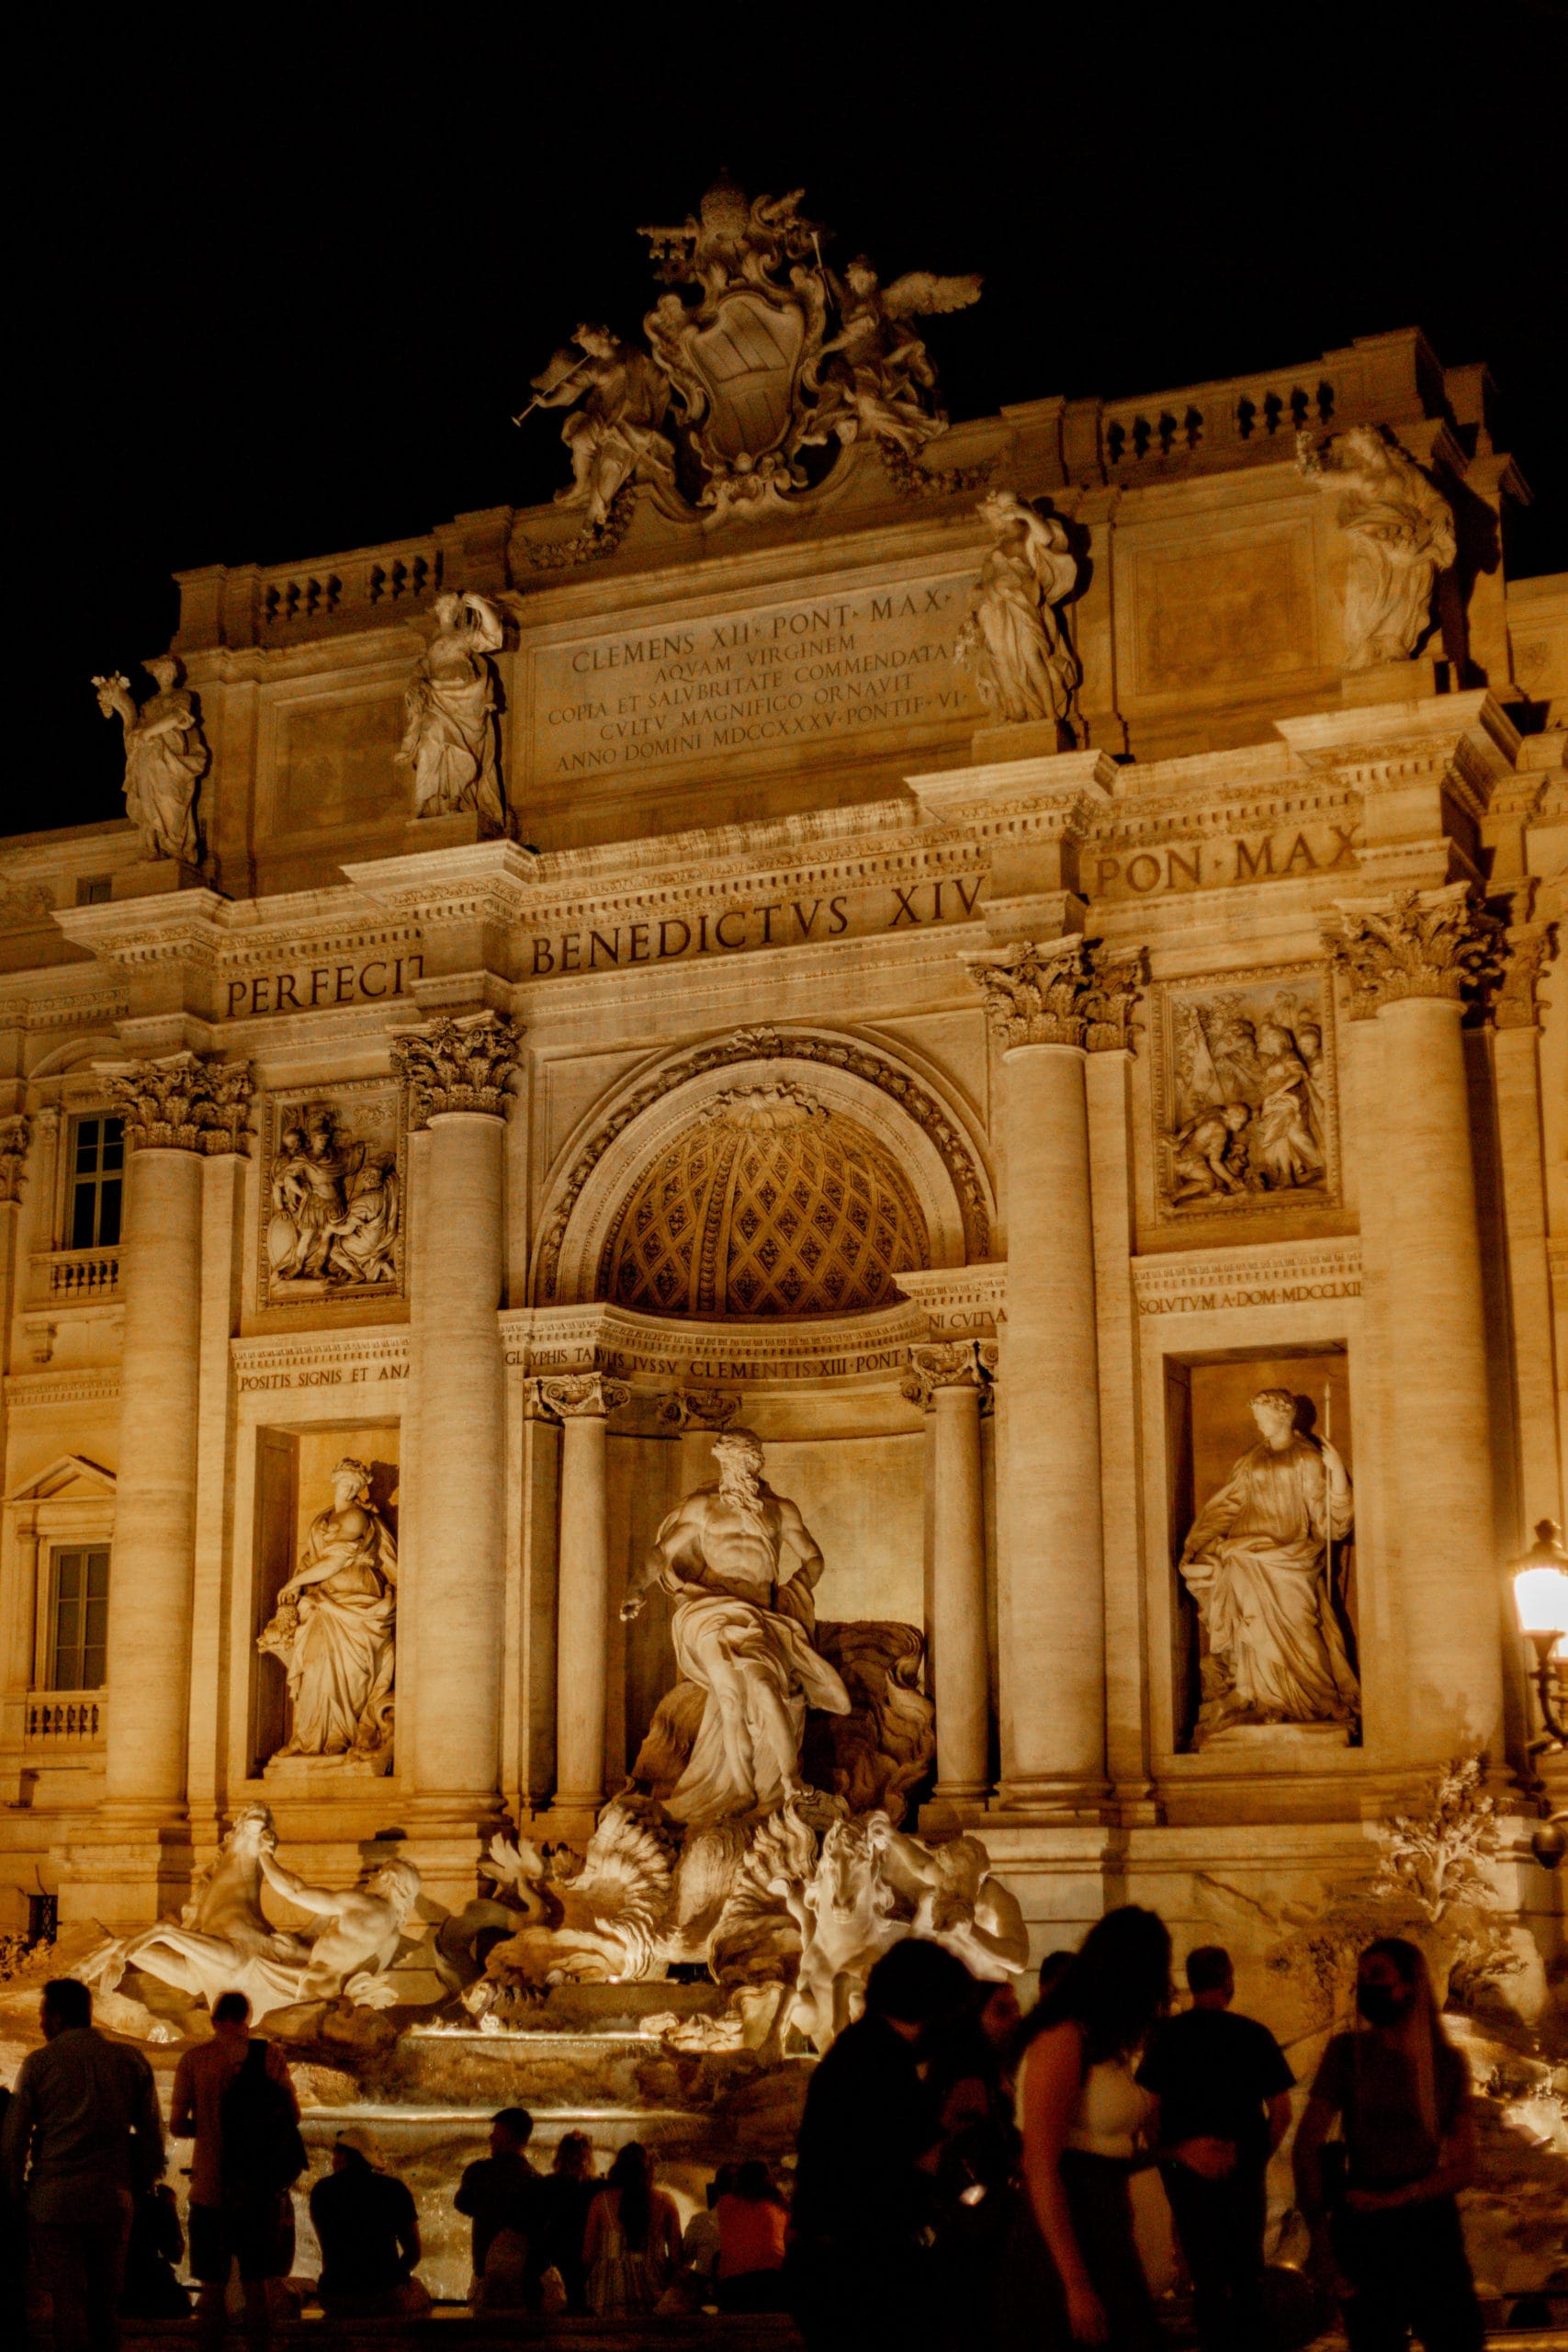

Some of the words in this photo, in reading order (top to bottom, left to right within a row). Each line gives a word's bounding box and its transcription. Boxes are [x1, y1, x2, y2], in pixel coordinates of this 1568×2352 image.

[572, 632, 694, 673] CLEMENS
[654, 654, 730, 684] AQVAM
[747, 634, 855, 667] VIRGINEM
[548, 702, 607, 725] COPIA
[618, 695, 638, 715] ET
[649, 671, 783, 709] SALVBRITATE
[600, 716, 667, 741] CVLTV
[681, 693, 802, 728] MAGNIFICO
[815, 673, 912, 705] ORNAVIT
[557, 749, 616, 773] ANNO
[625, 734, 702, 762] DOMINI
[531, 896, 848, 975] BENEDICTVS
[887, 876, 986, 927] XIV
[1234, 823, 1360, 880] MAX
[1139, 1295, 1217, 1315] SOLVTVM
[241, 1374, 291, 1393] POSITIS
[298, 1369, 343, 1386] SIGNIS
[352, 1367, 369, 1383] ET
